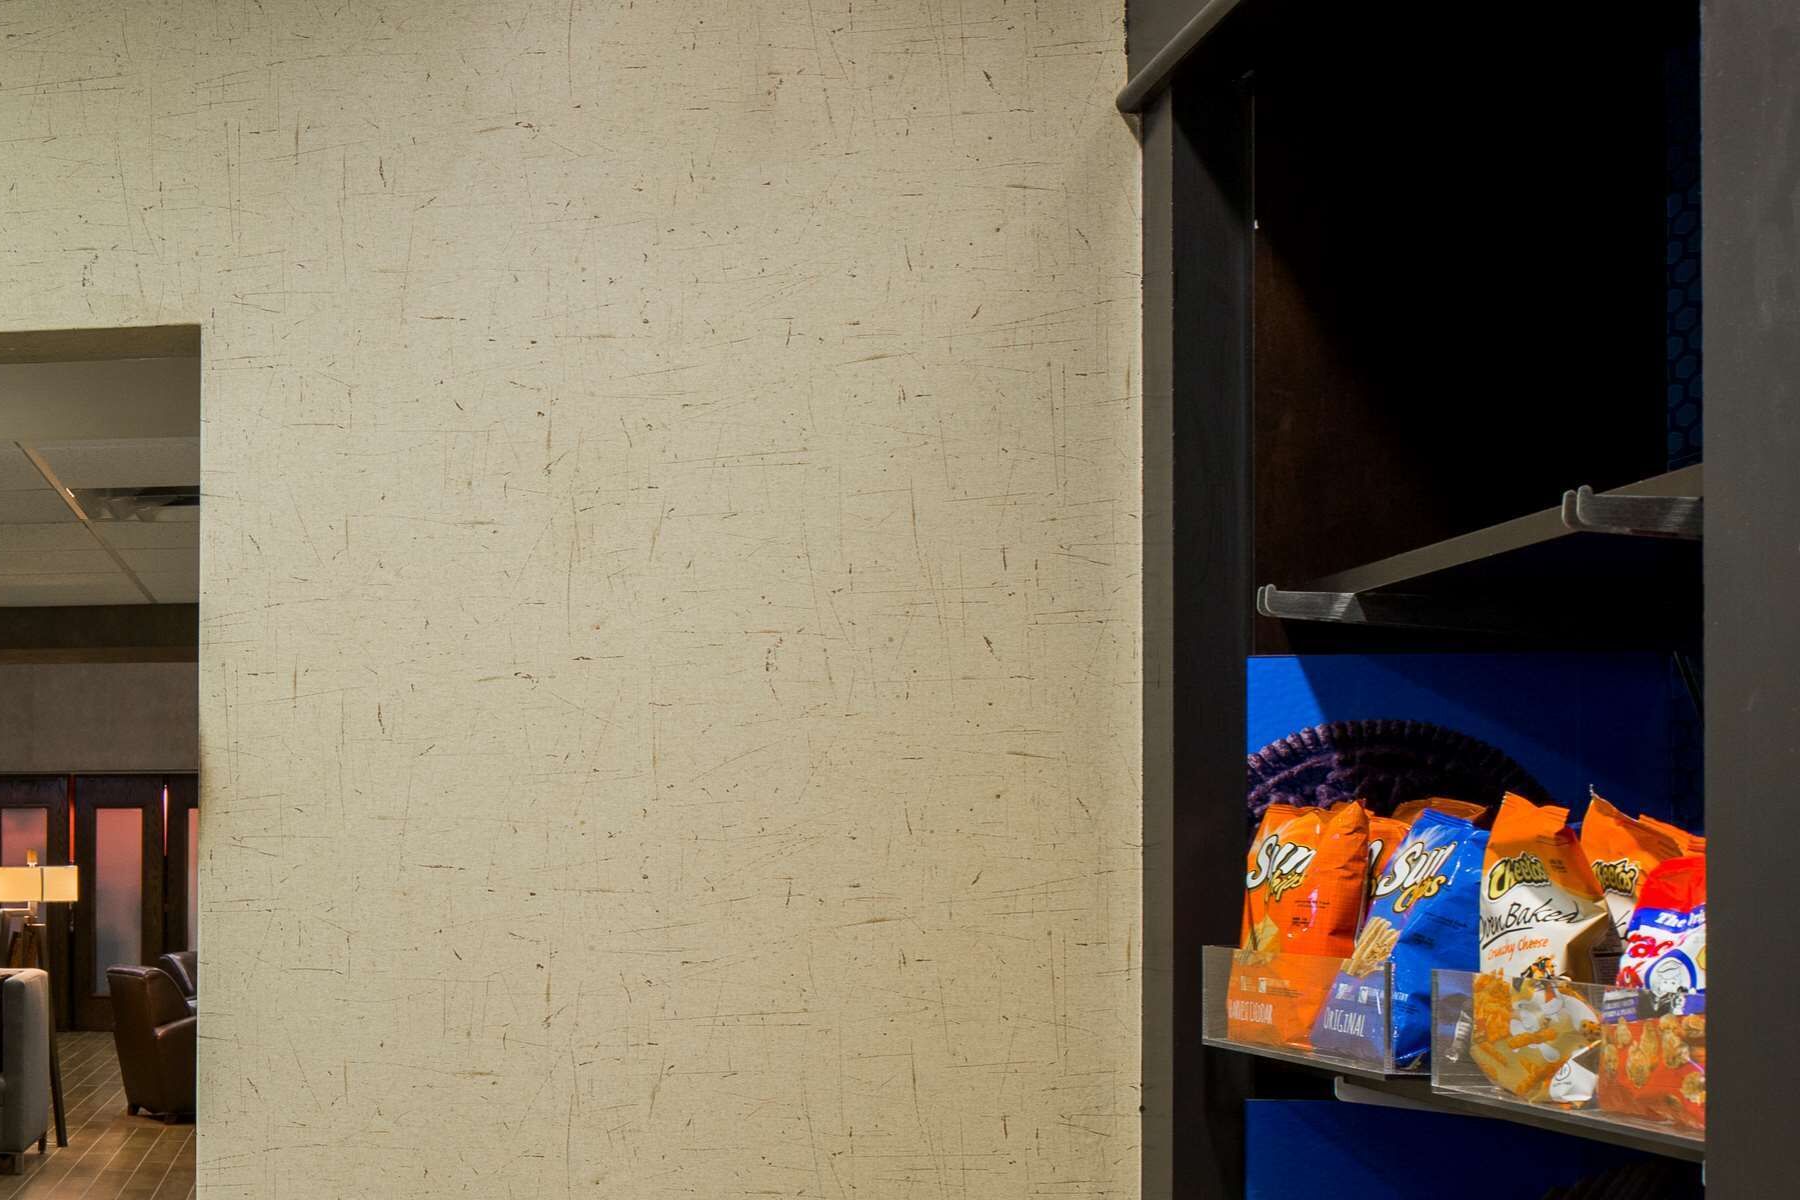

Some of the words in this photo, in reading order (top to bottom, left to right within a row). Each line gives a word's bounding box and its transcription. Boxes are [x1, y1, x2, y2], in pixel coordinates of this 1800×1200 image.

[1245, 833, 1318, 892] Sun
[1373, 840, 1459, 898] Sun
[1488, 850, 1550, 901] Cheetos
[1504, 898, 1588, 930] Baked
[1654, 911, 1687, 928] The
[1516, 935, 1550, 952] Cheese
[1322, 1006, 1366, 1038] ORIGINAL
